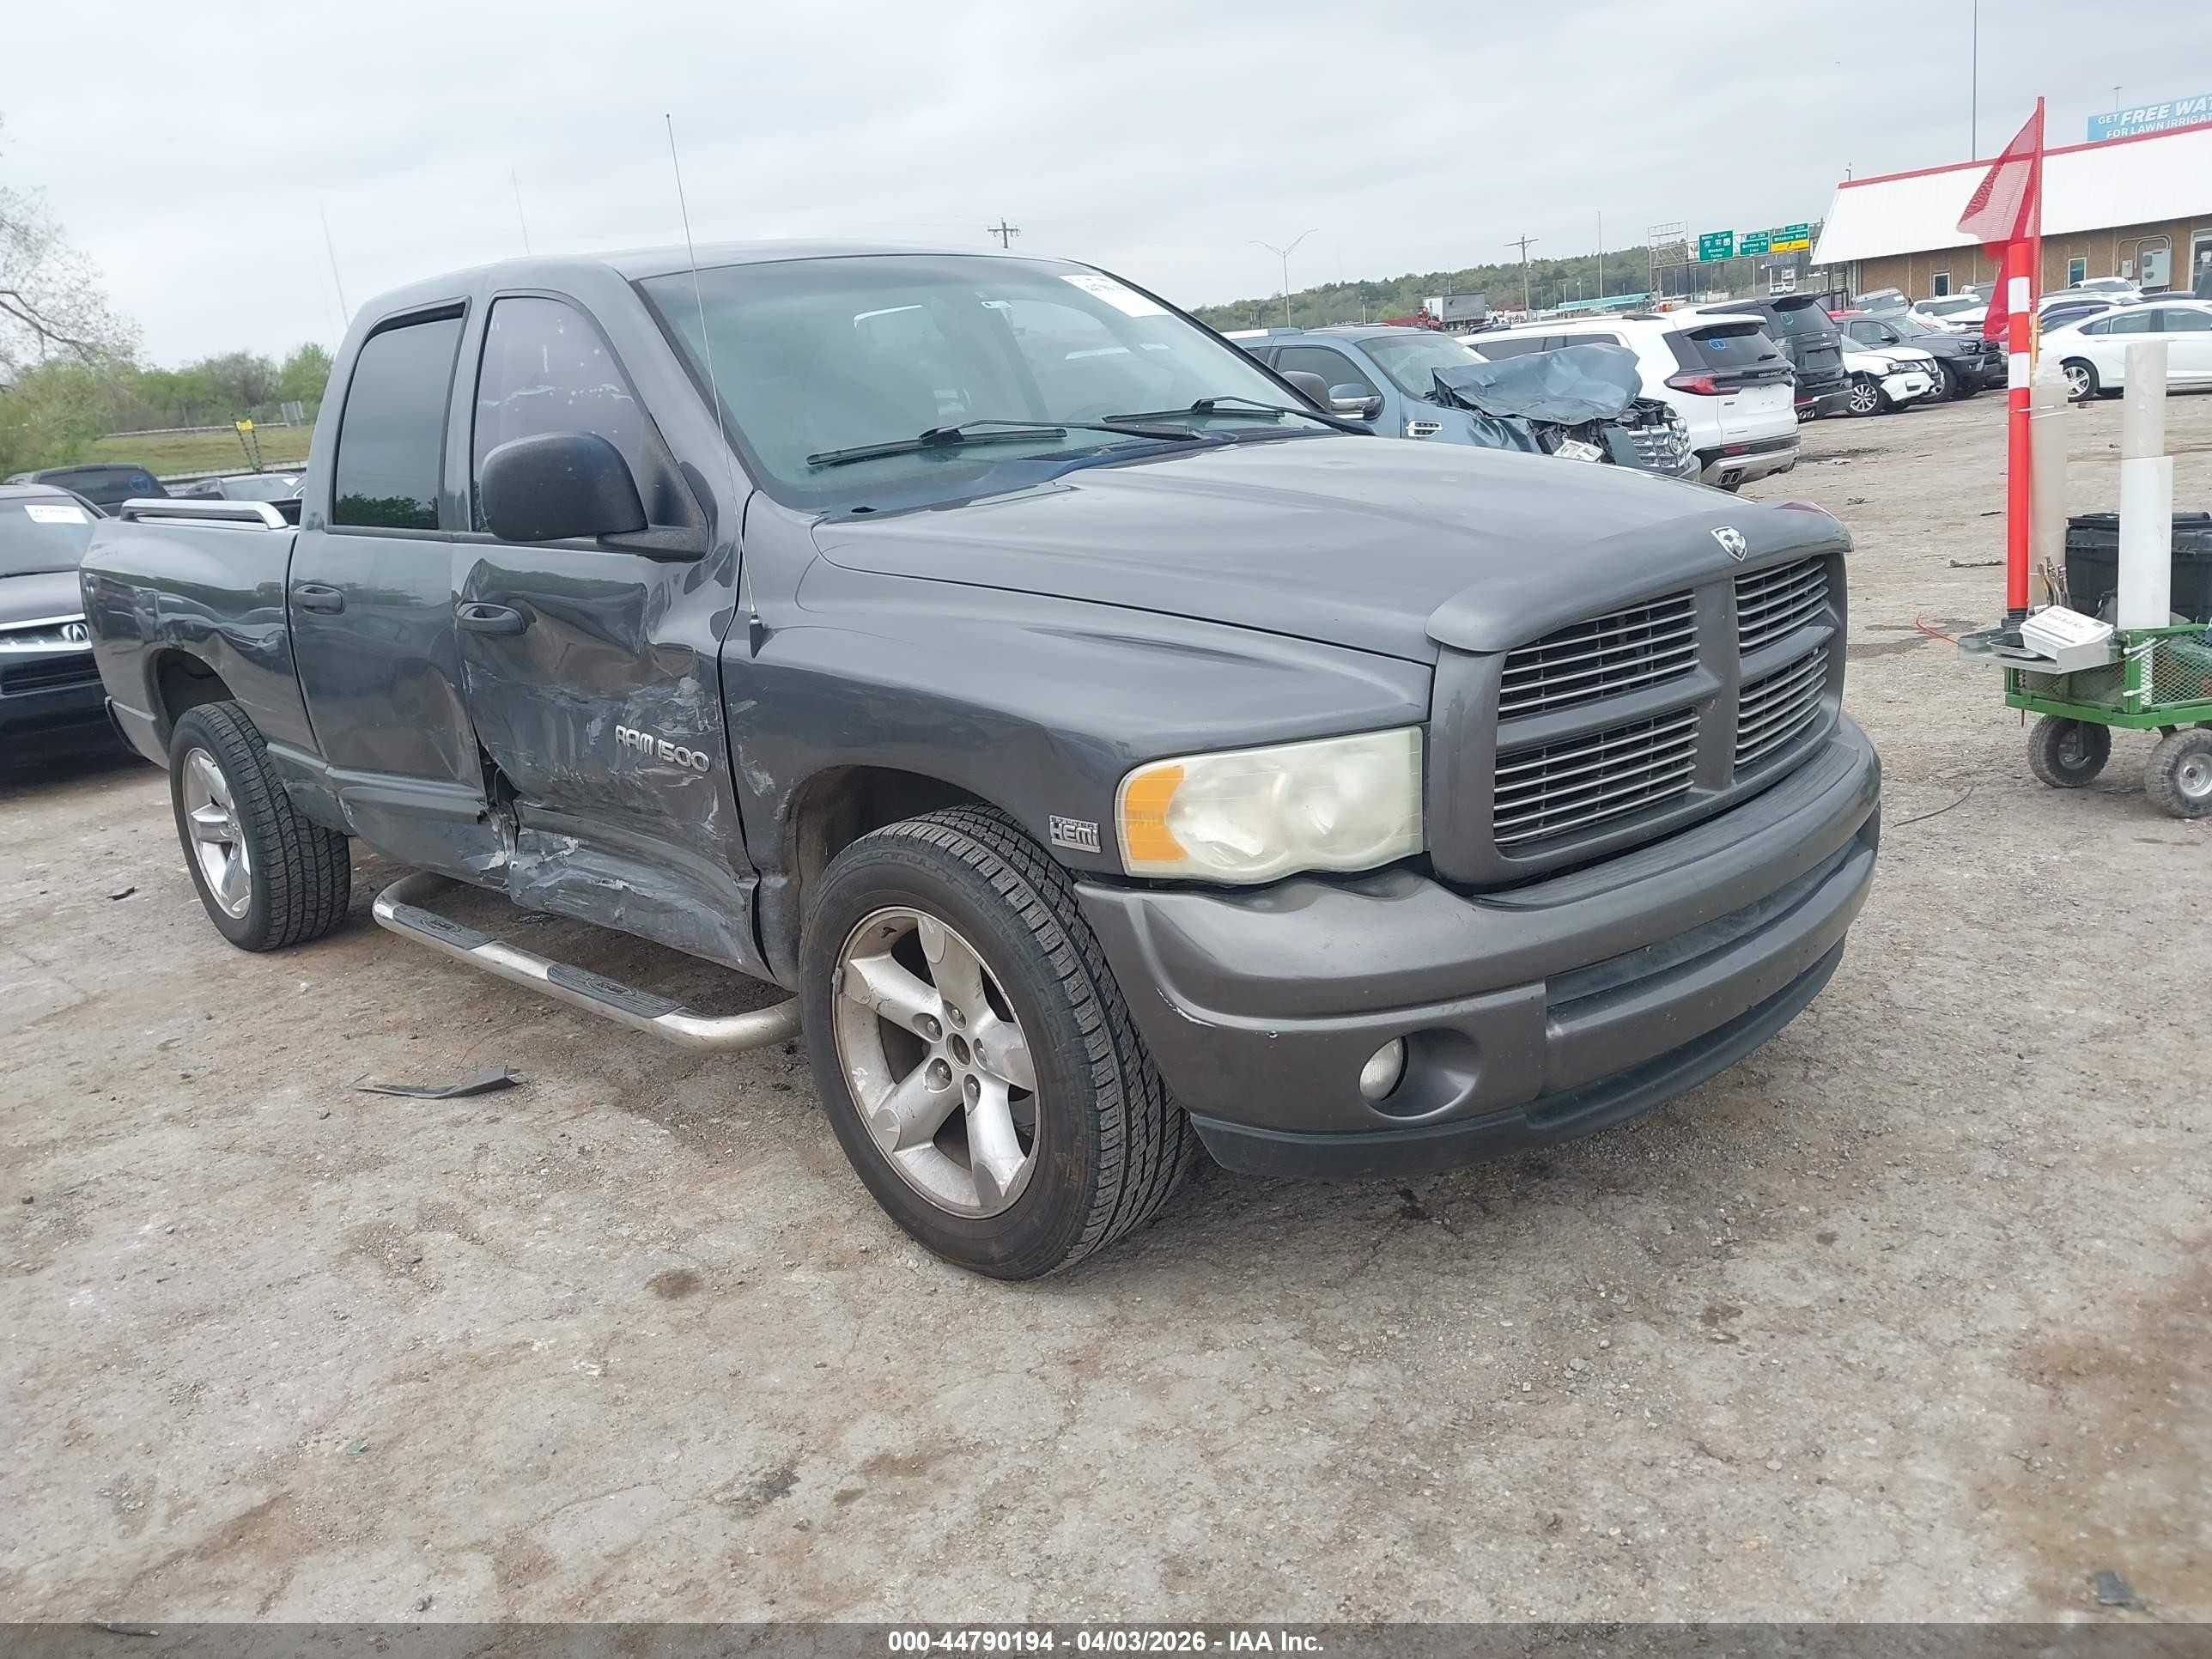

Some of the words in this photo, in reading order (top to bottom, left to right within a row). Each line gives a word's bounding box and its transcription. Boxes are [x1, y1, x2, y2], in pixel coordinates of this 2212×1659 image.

[2098, 113, 2119, 125] GET
[2120, 104, 2171, 125] FREE
[2106, 127, 2129, 138] FOR
[2131, 121, 2165, 135] LAWN
[614, 724, 655, 756] RAM
[657, 738, 711, 773] 1500
